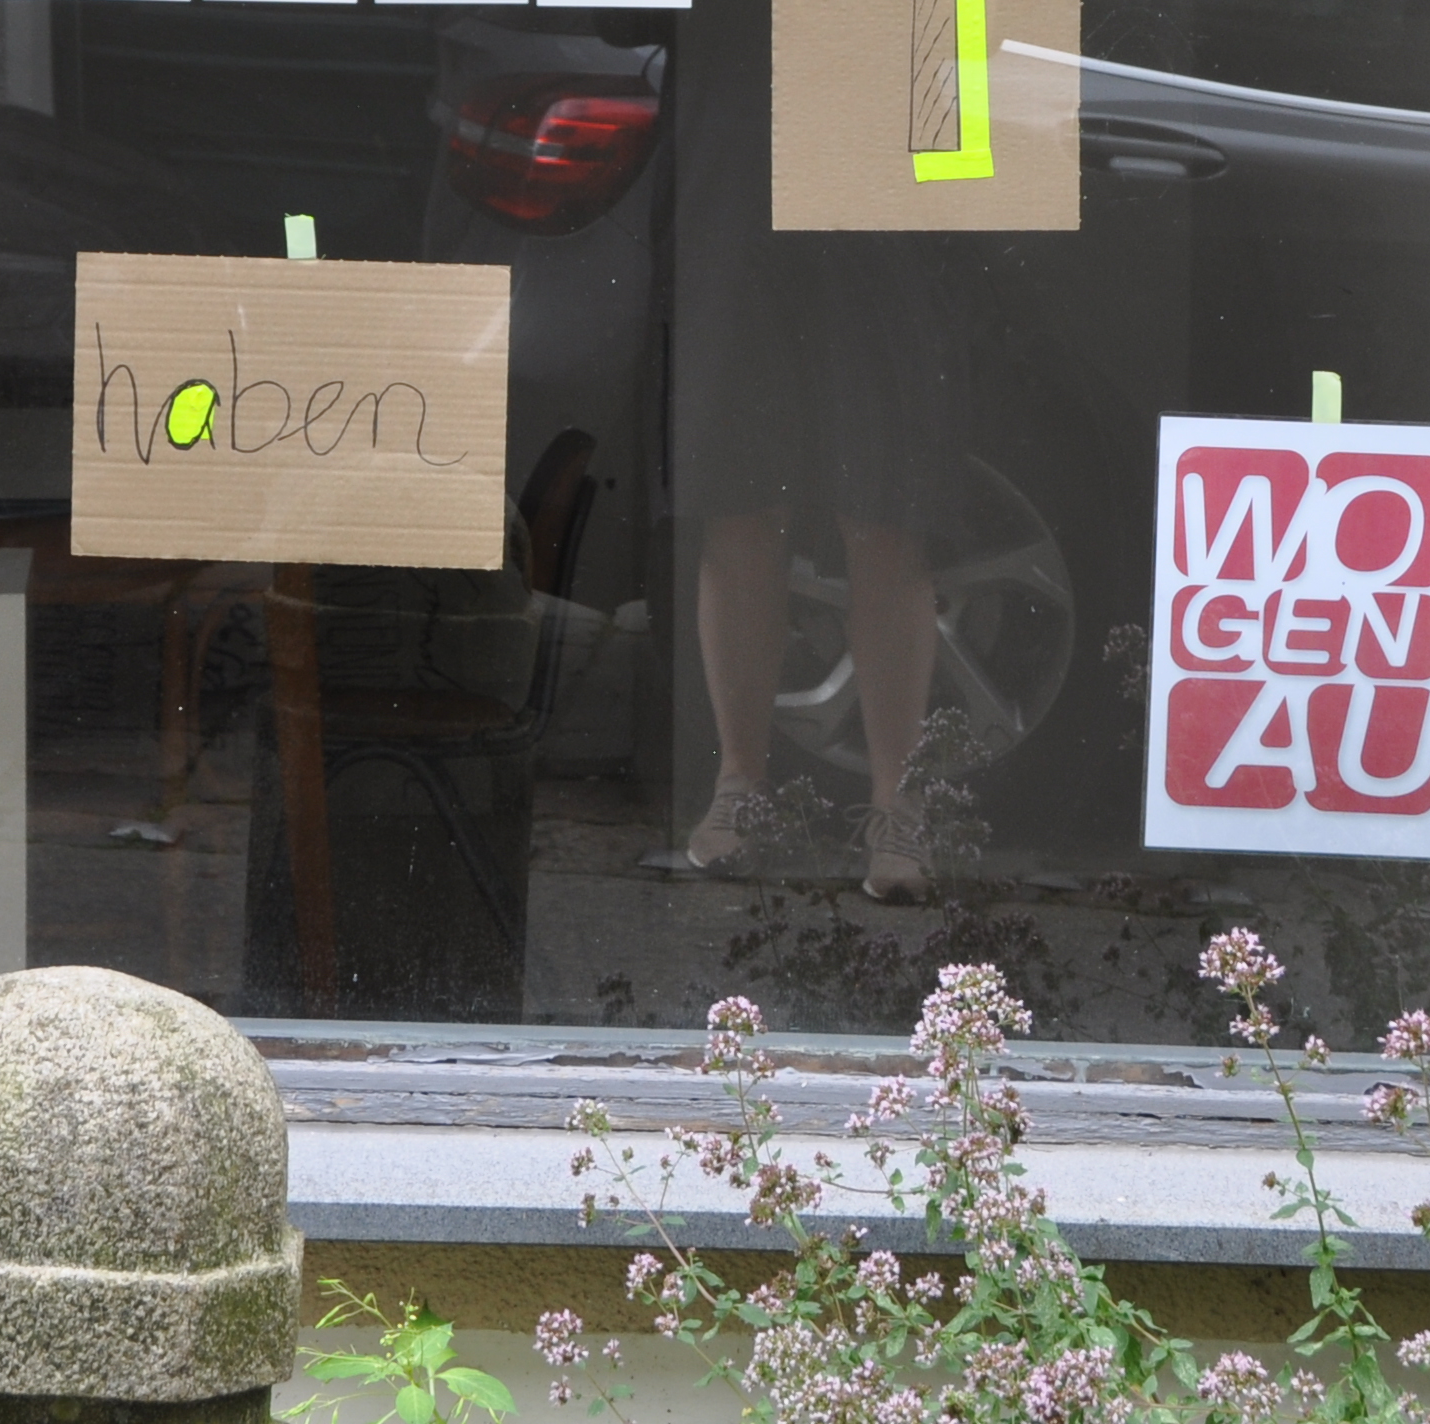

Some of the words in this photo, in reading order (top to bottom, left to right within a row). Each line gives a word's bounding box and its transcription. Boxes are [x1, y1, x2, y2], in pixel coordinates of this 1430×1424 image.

[95, 321, 469, 467] haben
[1182, 472, 1426, 586] WO
[1182, 582, 1421, 668] GEN
